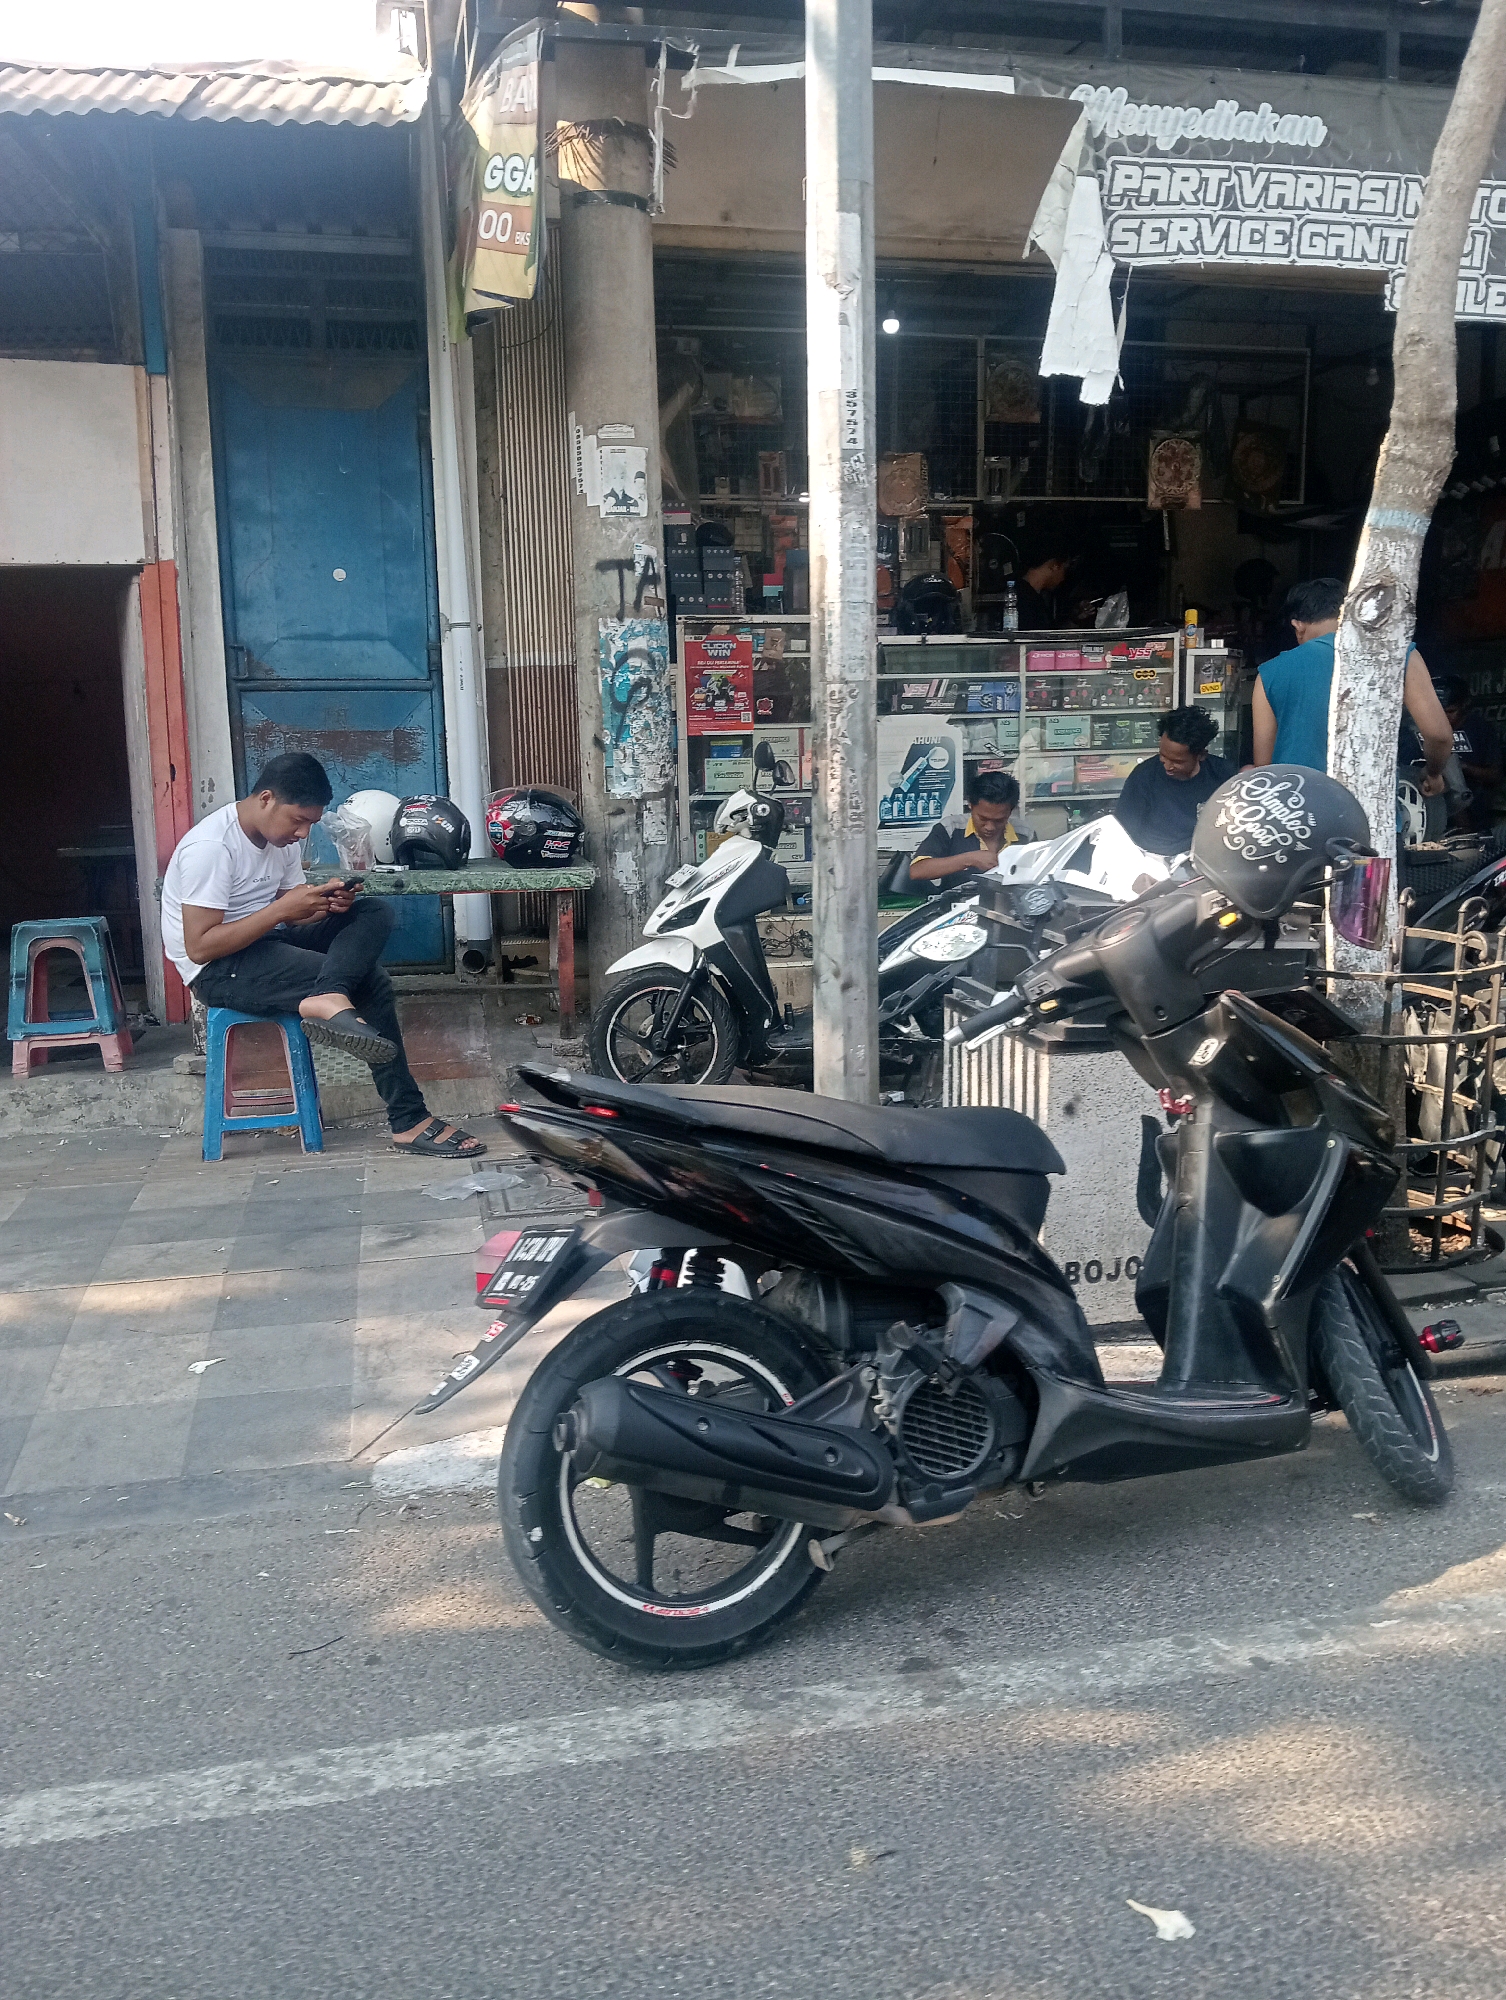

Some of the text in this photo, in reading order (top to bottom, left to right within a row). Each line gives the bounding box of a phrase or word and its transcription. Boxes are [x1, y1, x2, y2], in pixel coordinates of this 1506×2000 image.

[1069, 84, 1328, 150] Menyediakan
[1112, 162, 1232, 208] PART
[1236, 167, 1397, 217] VARIASI
[478, 210, 512, 242] 00
[1111, 217, 1292, 258] SERVICE
[1452, 732, 1466, 742] BA
